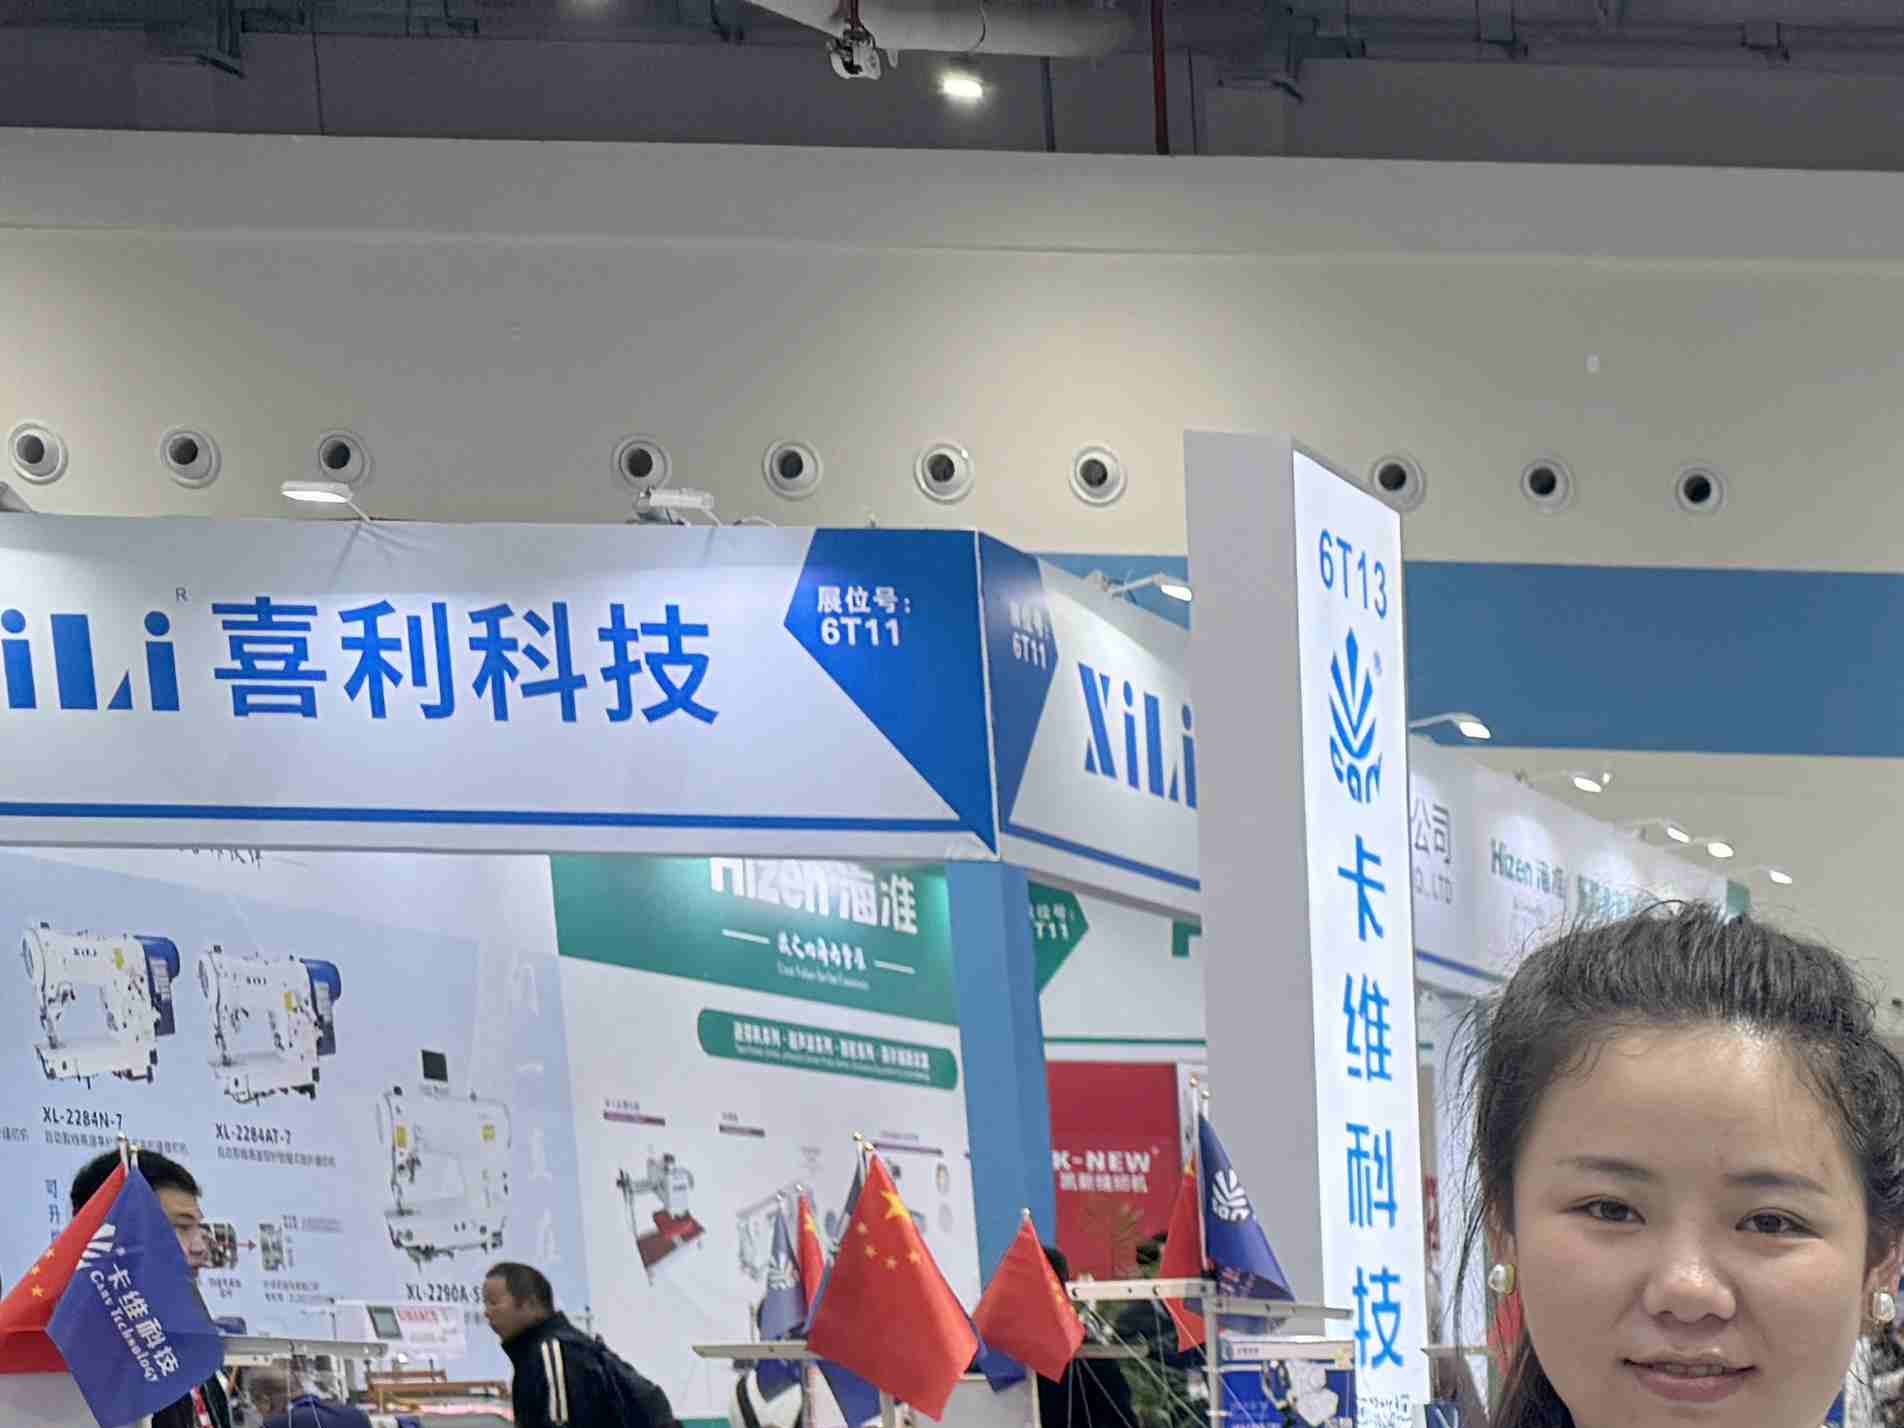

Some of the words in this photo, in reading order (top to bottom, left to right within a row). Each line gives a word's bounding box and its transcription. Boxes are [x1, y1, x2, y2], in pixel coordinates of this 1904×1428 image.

[1318, 529, 1388, 620] 6T13
[211, 597, 719, 726] 喜利科技
[820, 616, 902, 646] 6T11
[1011, 632, 1047, 669] 6T11
[42, 1105, 123, 1130] XL-2284N-7
[1337, 833, 1405, 1369] 卡维科技
[1052, 1150, 1150, 1173] K-NEW
[107, 1262, 180, 1377] 卡维科技
